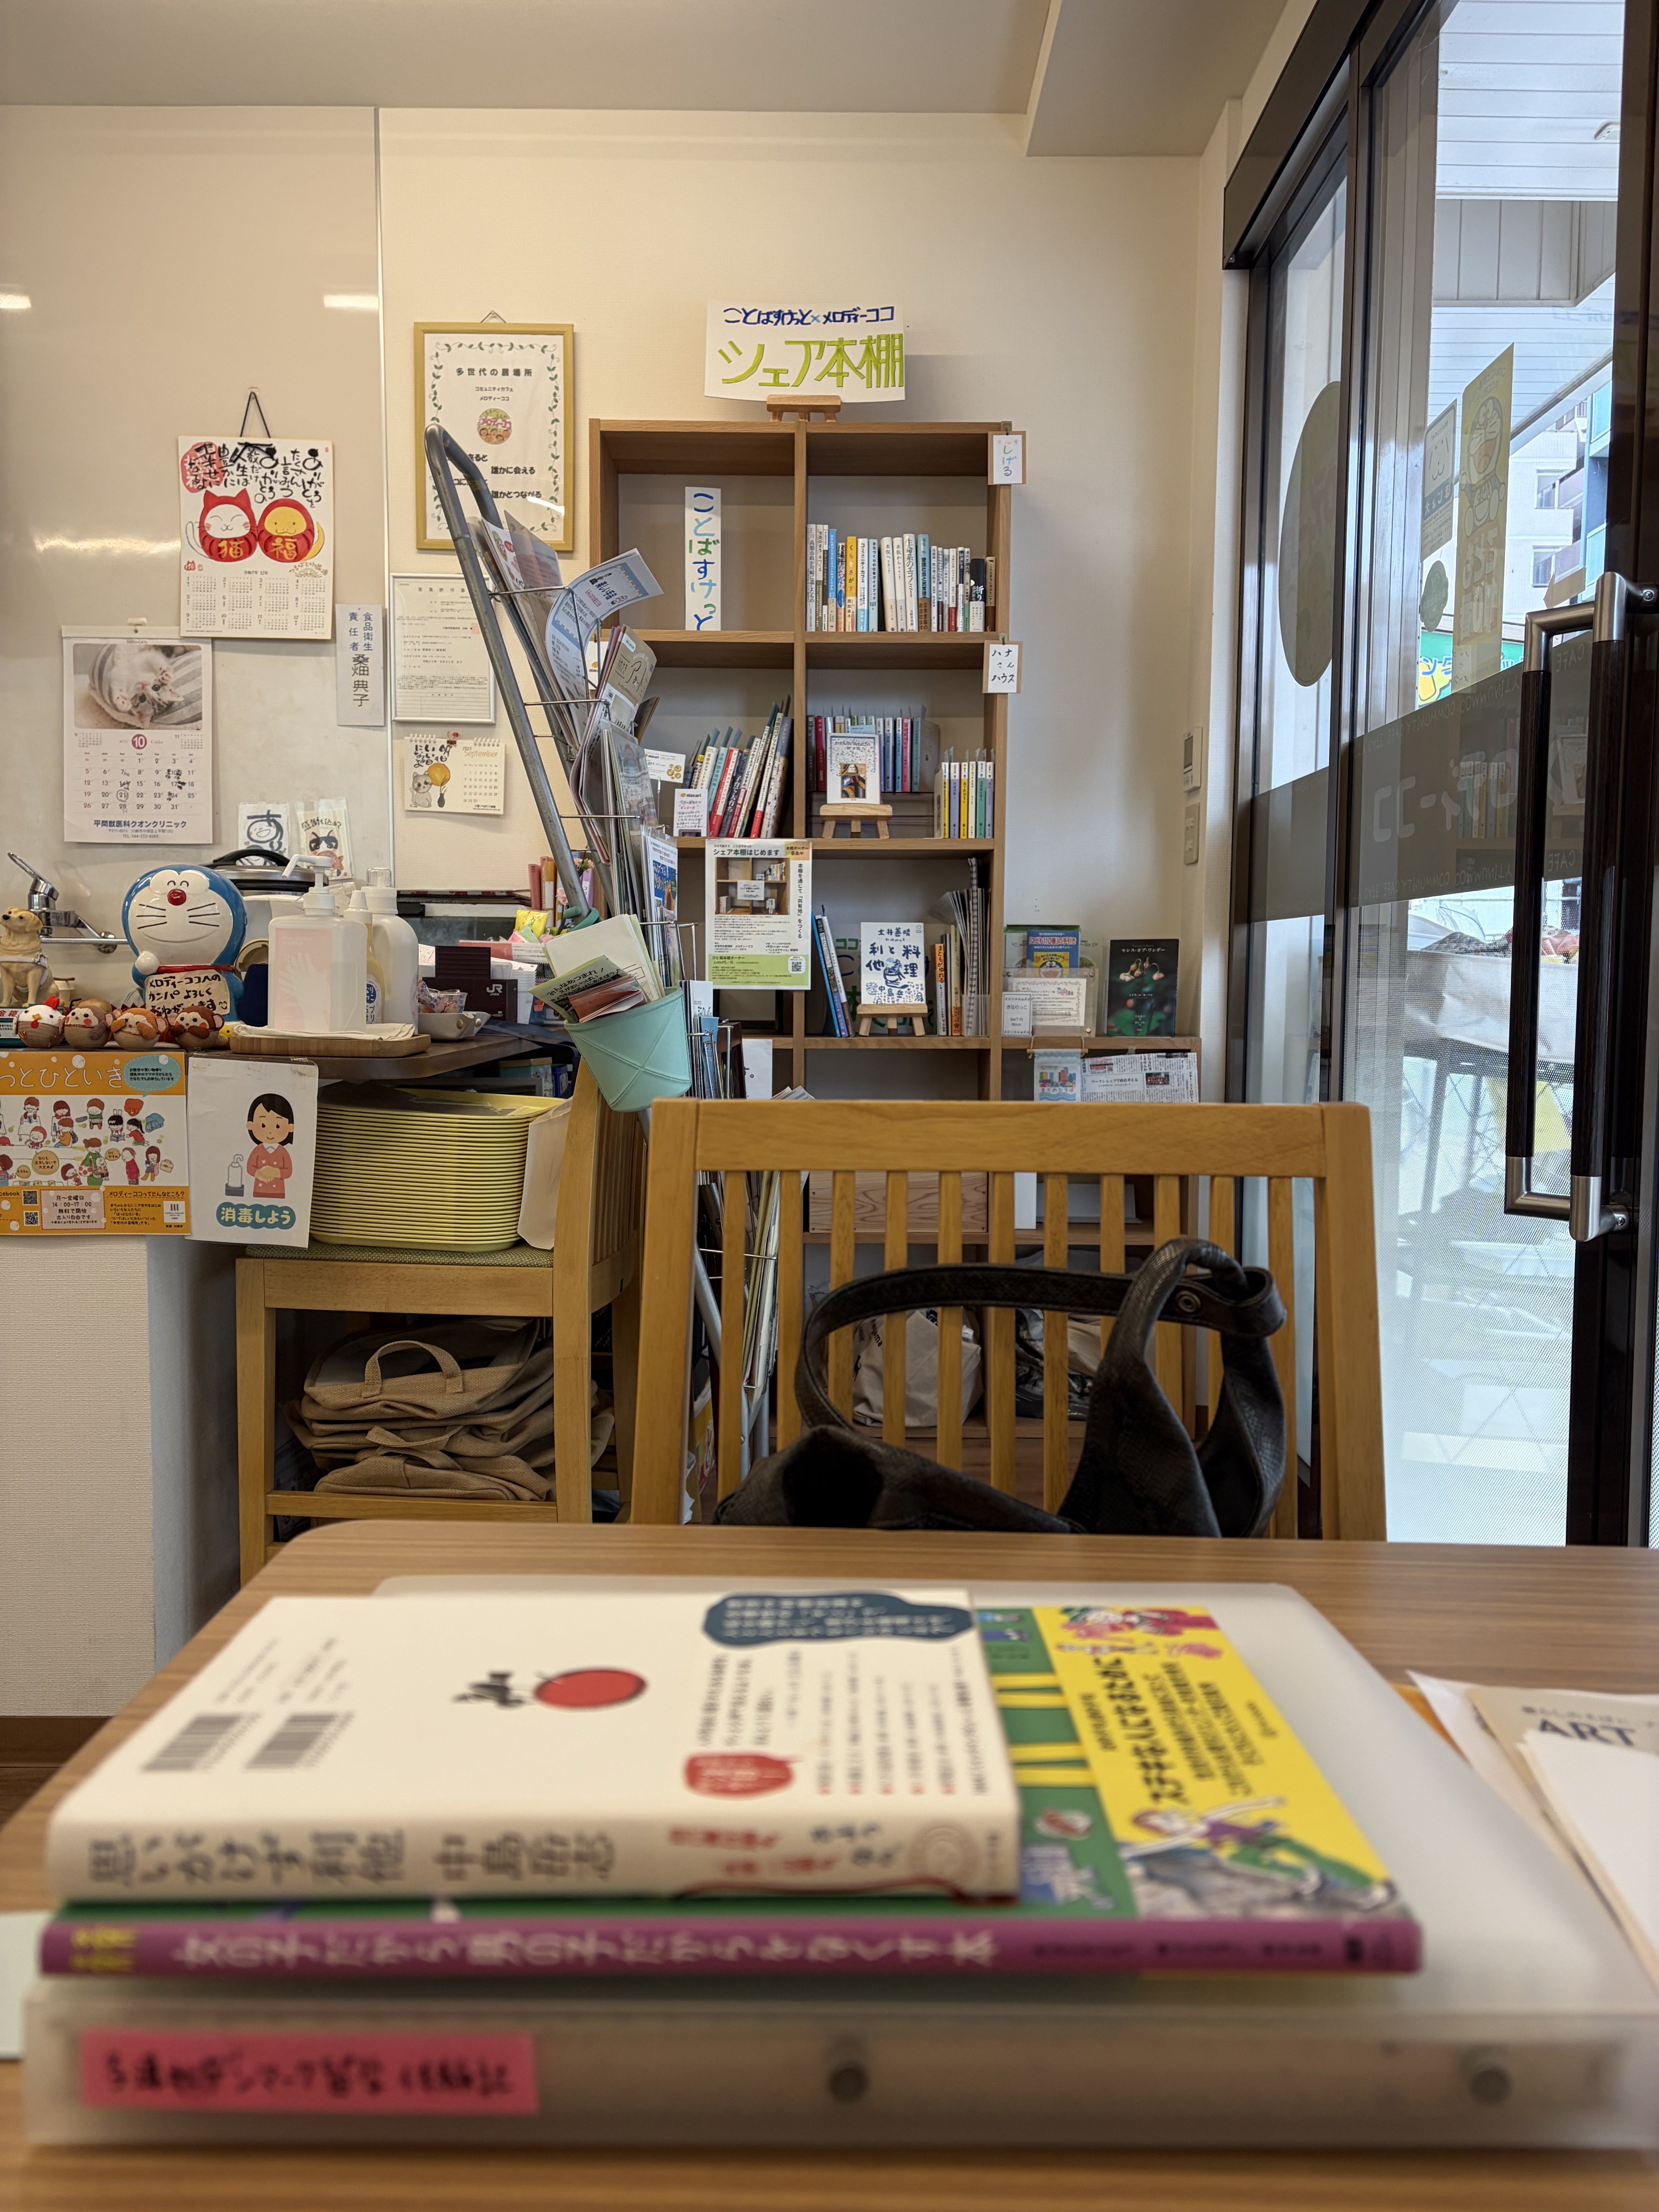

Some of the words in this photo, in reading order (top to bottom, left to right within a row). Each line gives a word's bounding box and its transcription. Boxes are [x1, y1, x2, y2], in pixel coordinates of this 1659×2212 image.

[718, 333, 903, 388] シェア本棚
[456, 368, 532, 377] 多世代の居場所
[491, 466, 535, 475] 誰かに会える
[491, 490, 542, 499] 誰かとつながる
[218, 540, 244, 559] 猫
[271, 537, 297, 560] 福
[689, 493, 720, 630] ことばすけっと
[349, 612, 359, 651] 責任者
[363, 612, 373, 651] 食品衛生
[992, 649, 1012, 657] ハナ
[352, 654, 369, 707] 桑畑典子
[991, 673, 1015, 683] ハウス
[133, 736, 145, 747] 10
[464, 750, 498, 758] September
[878, 927, 910, 937] 土井善晴
[866, 942, 884, 971] 利他
[889, 946, 895, 954] と
[902, 944, 921, 977] 料理
[148, 974, 222, 988] メロディーココへの
[148, 990, 180, 1001] カンパ
[185, 988, 212, 999] よろしく
[486, 984, 503, 993] JR
[221, 1207, 291, 1224] 消毒しよう
[1539, 1719, 1635, 1747] ART
